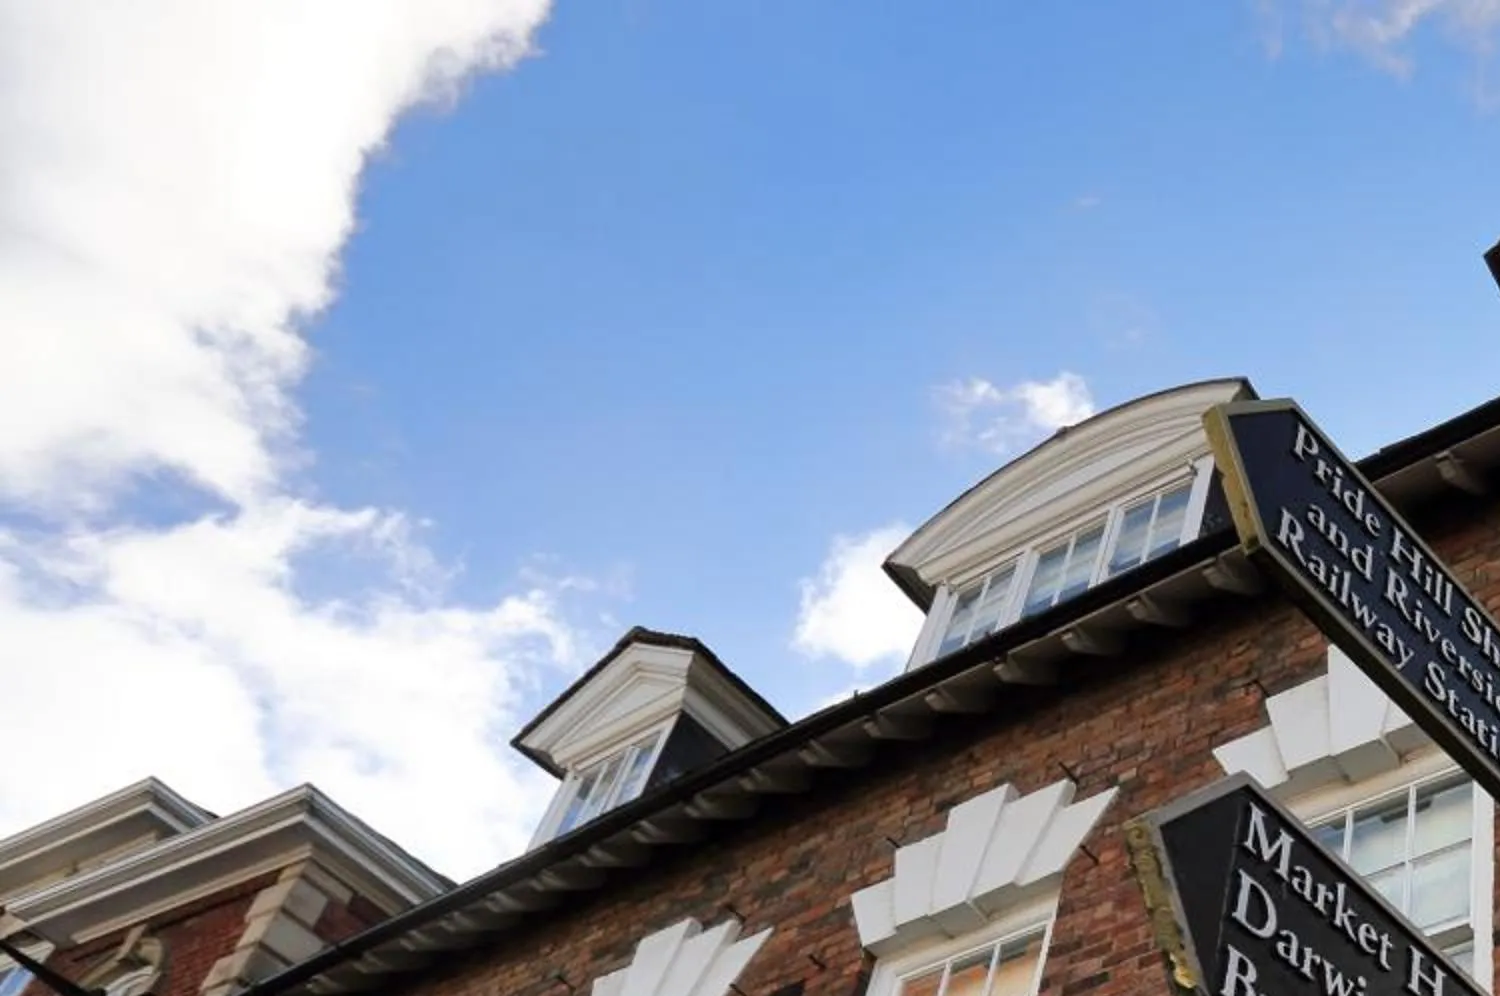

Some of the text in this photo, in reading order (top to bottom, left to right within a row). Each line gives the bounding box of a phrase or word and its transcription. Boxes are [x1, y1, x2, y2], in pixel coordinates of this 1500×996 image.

[1277, 509, 1414, 672] Railway
[1295, 424, 1380, 537] Pride
[1392, 523, 1453, 614] Hill
[1307, 503, 1373, 579] and
[1243, 802, 1393, 970] Market
